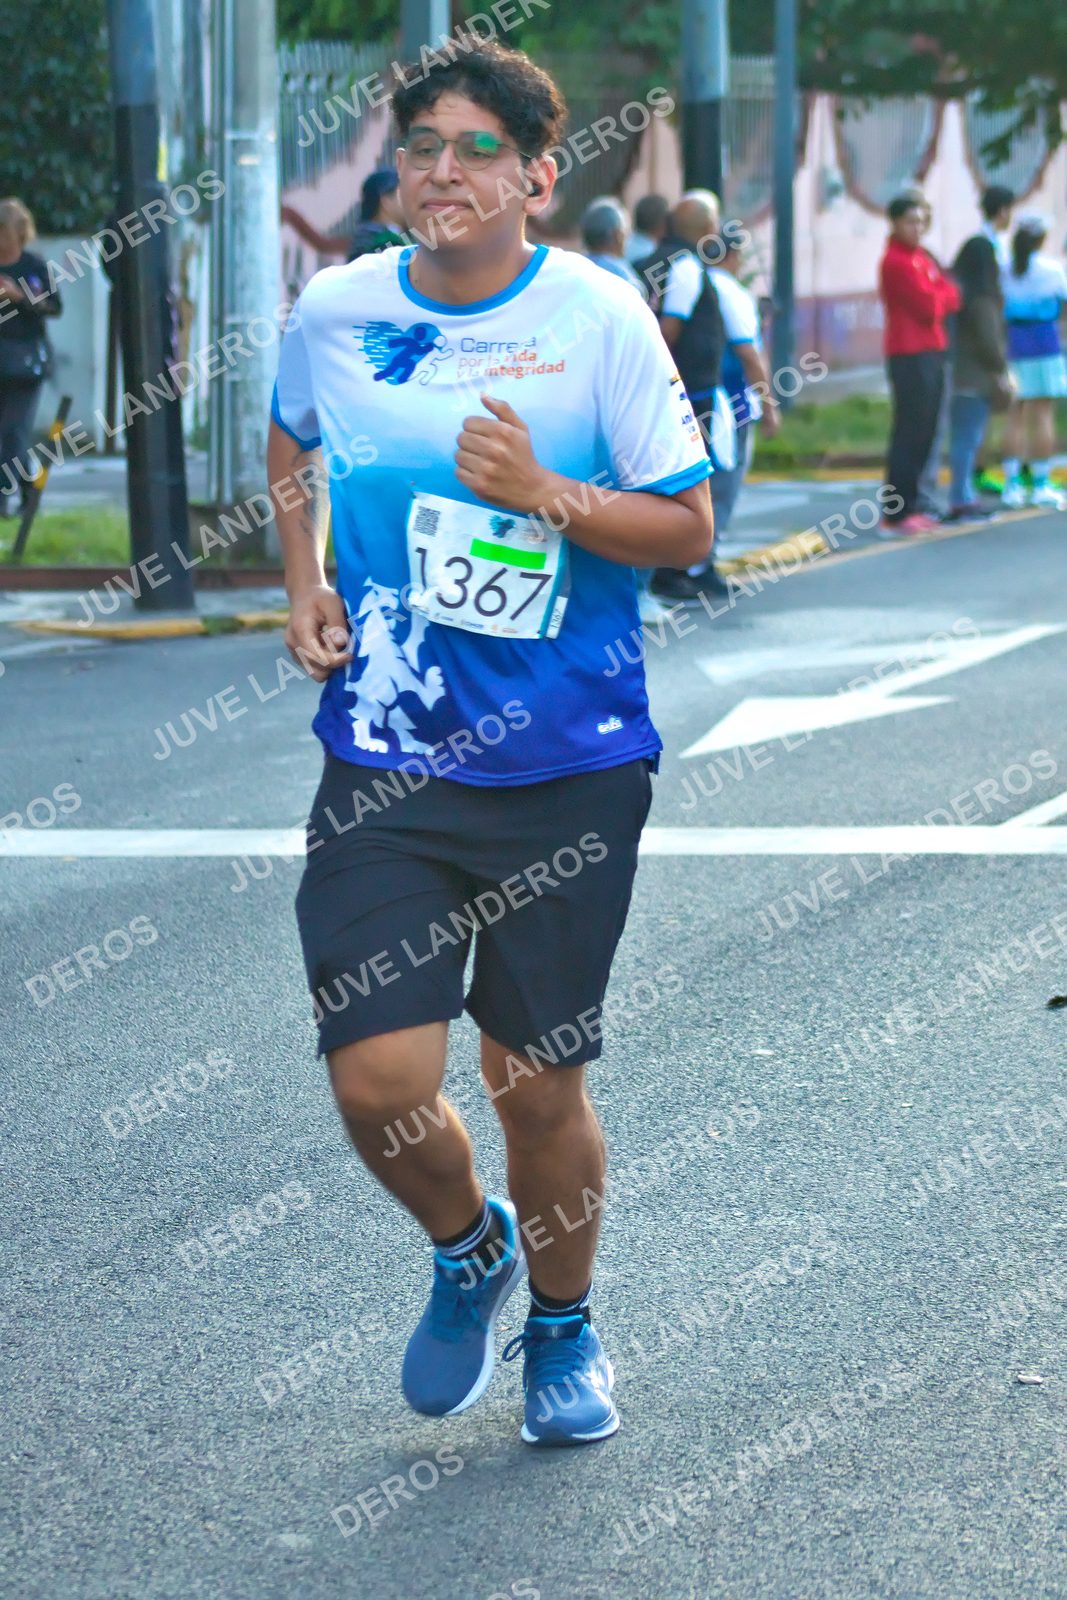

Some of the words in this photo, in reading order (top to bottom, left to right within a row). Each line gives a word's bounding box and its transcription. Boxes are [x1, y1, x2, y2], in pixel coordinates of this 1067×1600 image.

[460, 336, 537, 354] Carrea
[503, 349, 538, 363] ida
[415, 547, 553, 622] 1367
